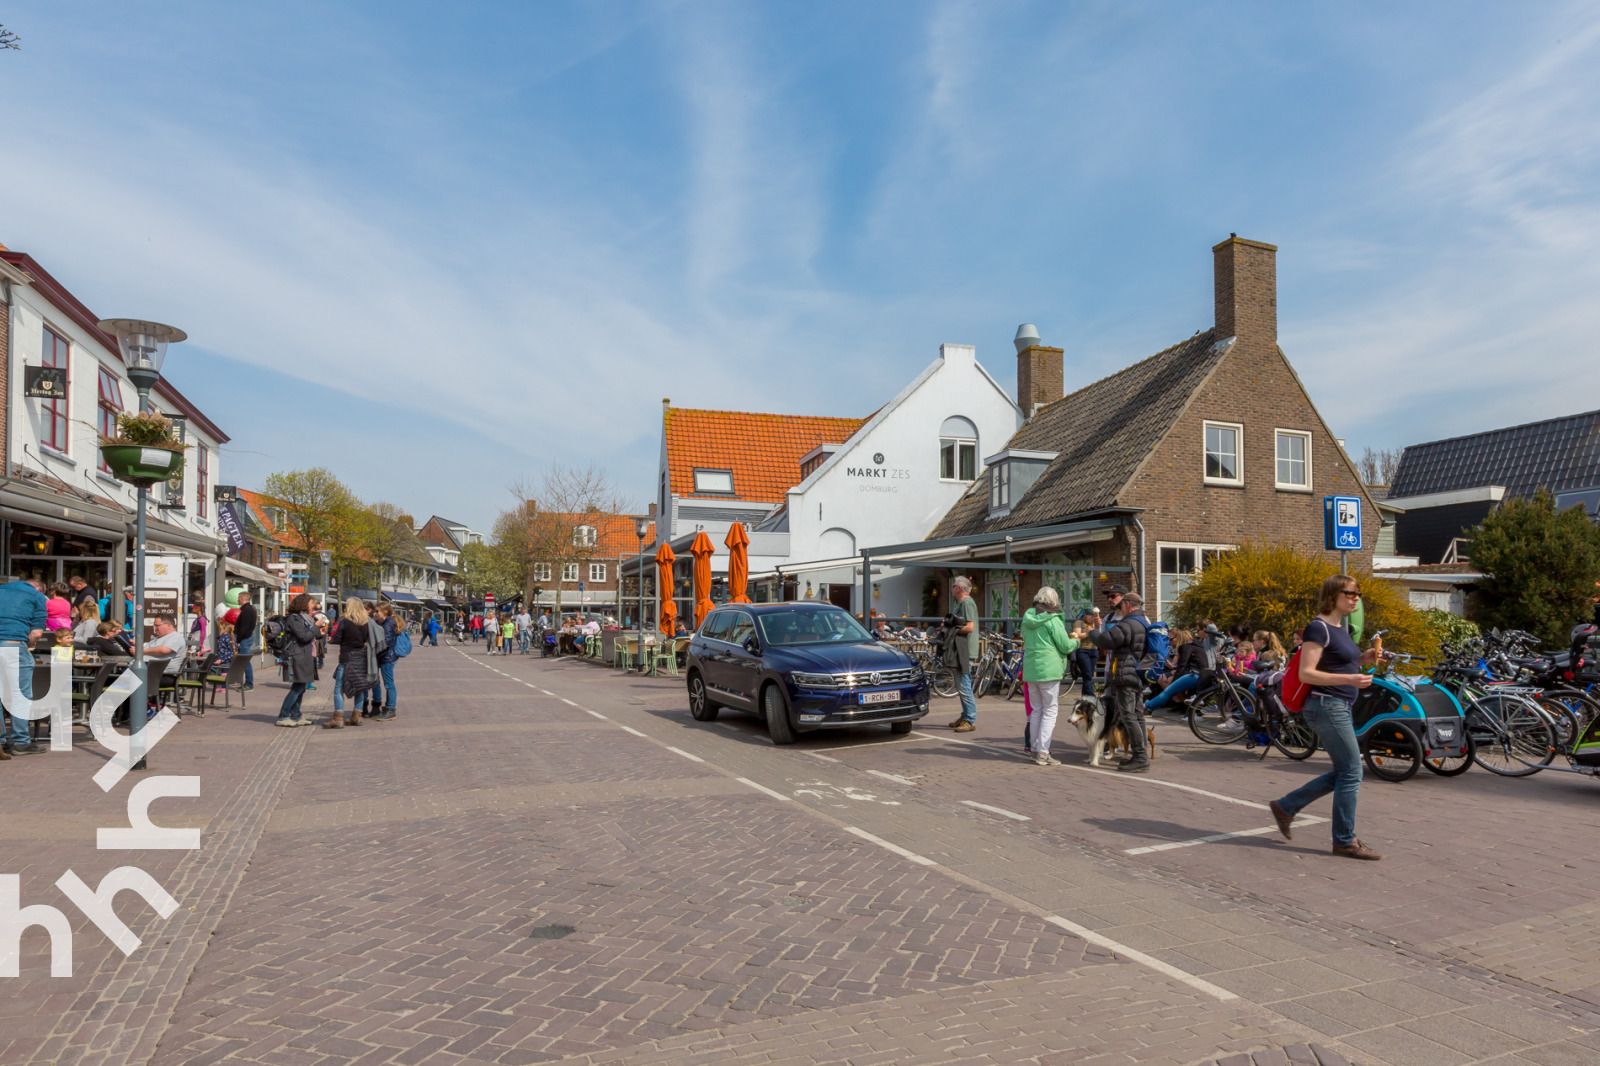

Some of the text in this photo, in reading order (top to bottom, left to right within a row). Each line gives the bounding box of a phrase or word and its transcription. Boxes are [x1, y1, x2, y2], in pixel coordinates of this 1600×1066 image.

[847, 467, 911, 480] MARKT ZES
[859, 485, 898, 493] DOMBURG
[865, 693, 899, 702] 1-RCH-961
